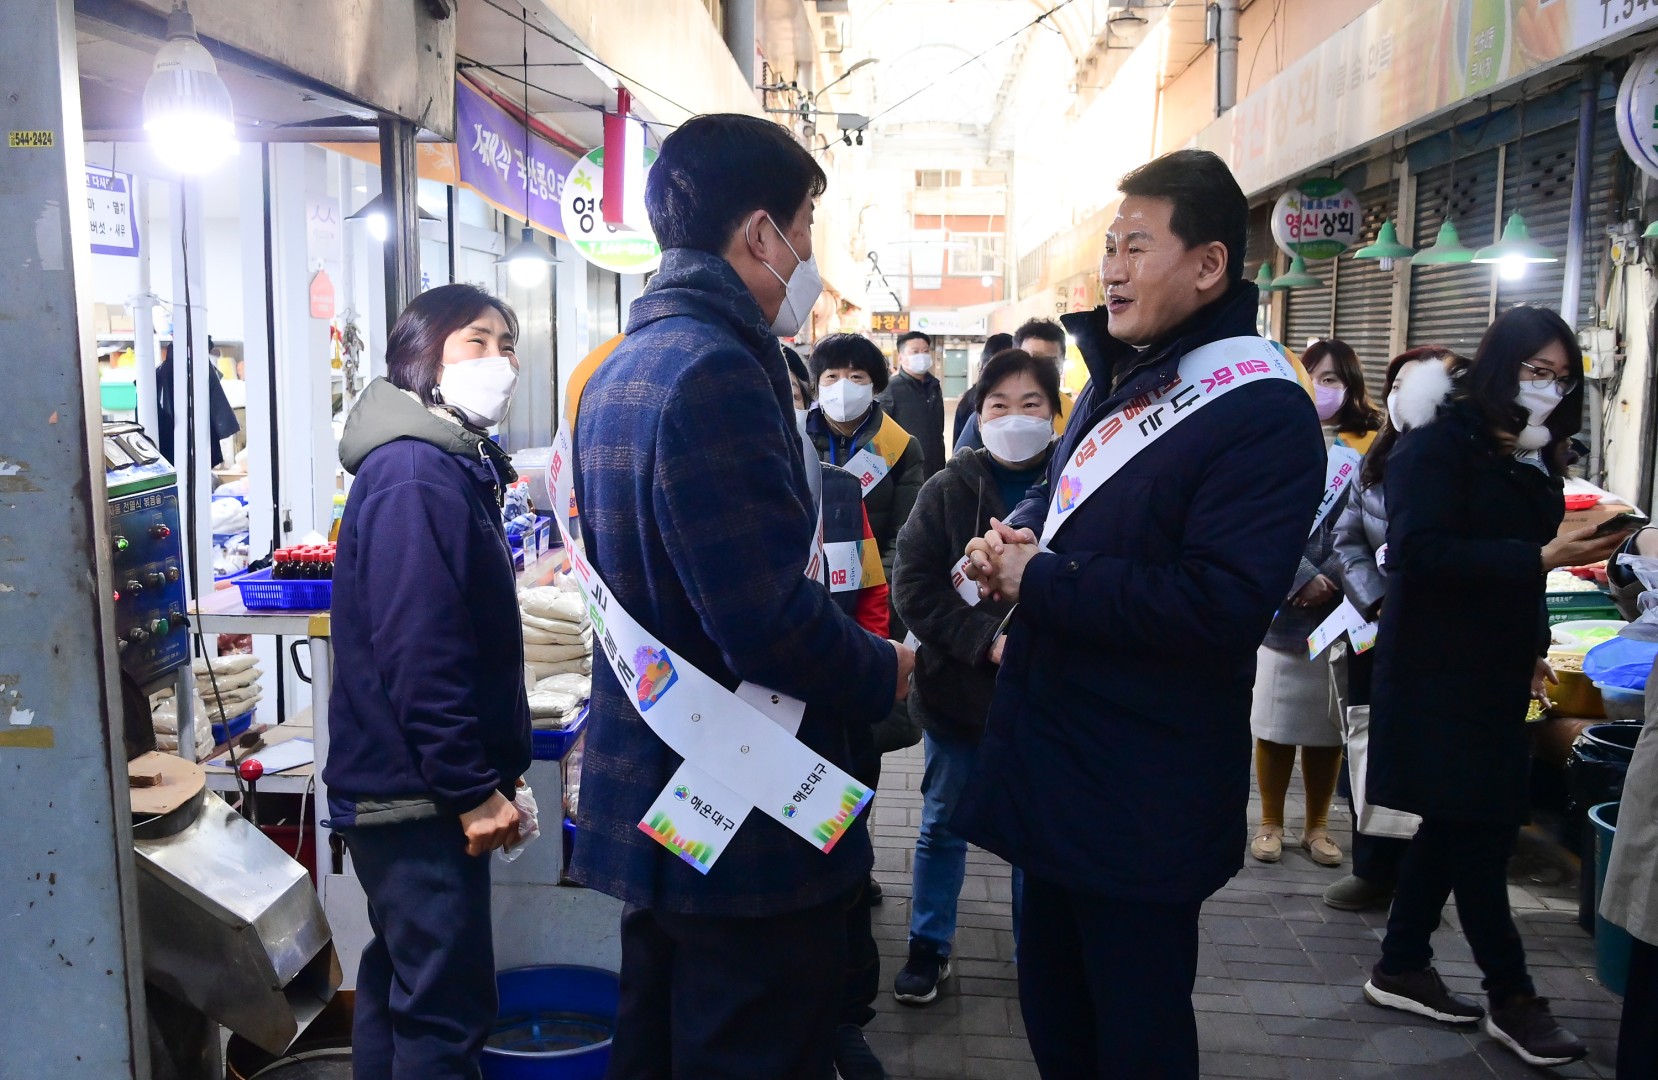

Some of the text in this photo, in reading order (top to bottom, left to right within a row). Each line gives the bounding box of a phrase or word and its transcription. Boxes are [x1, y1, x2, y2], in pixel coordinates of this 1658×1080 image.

[1285, 211, 1354, 238] 영신상회
[831, 569, 847, 586] 명
[792, 762, 828, 803] 해운대구
[690, 795, 736, 832] 해운대구
